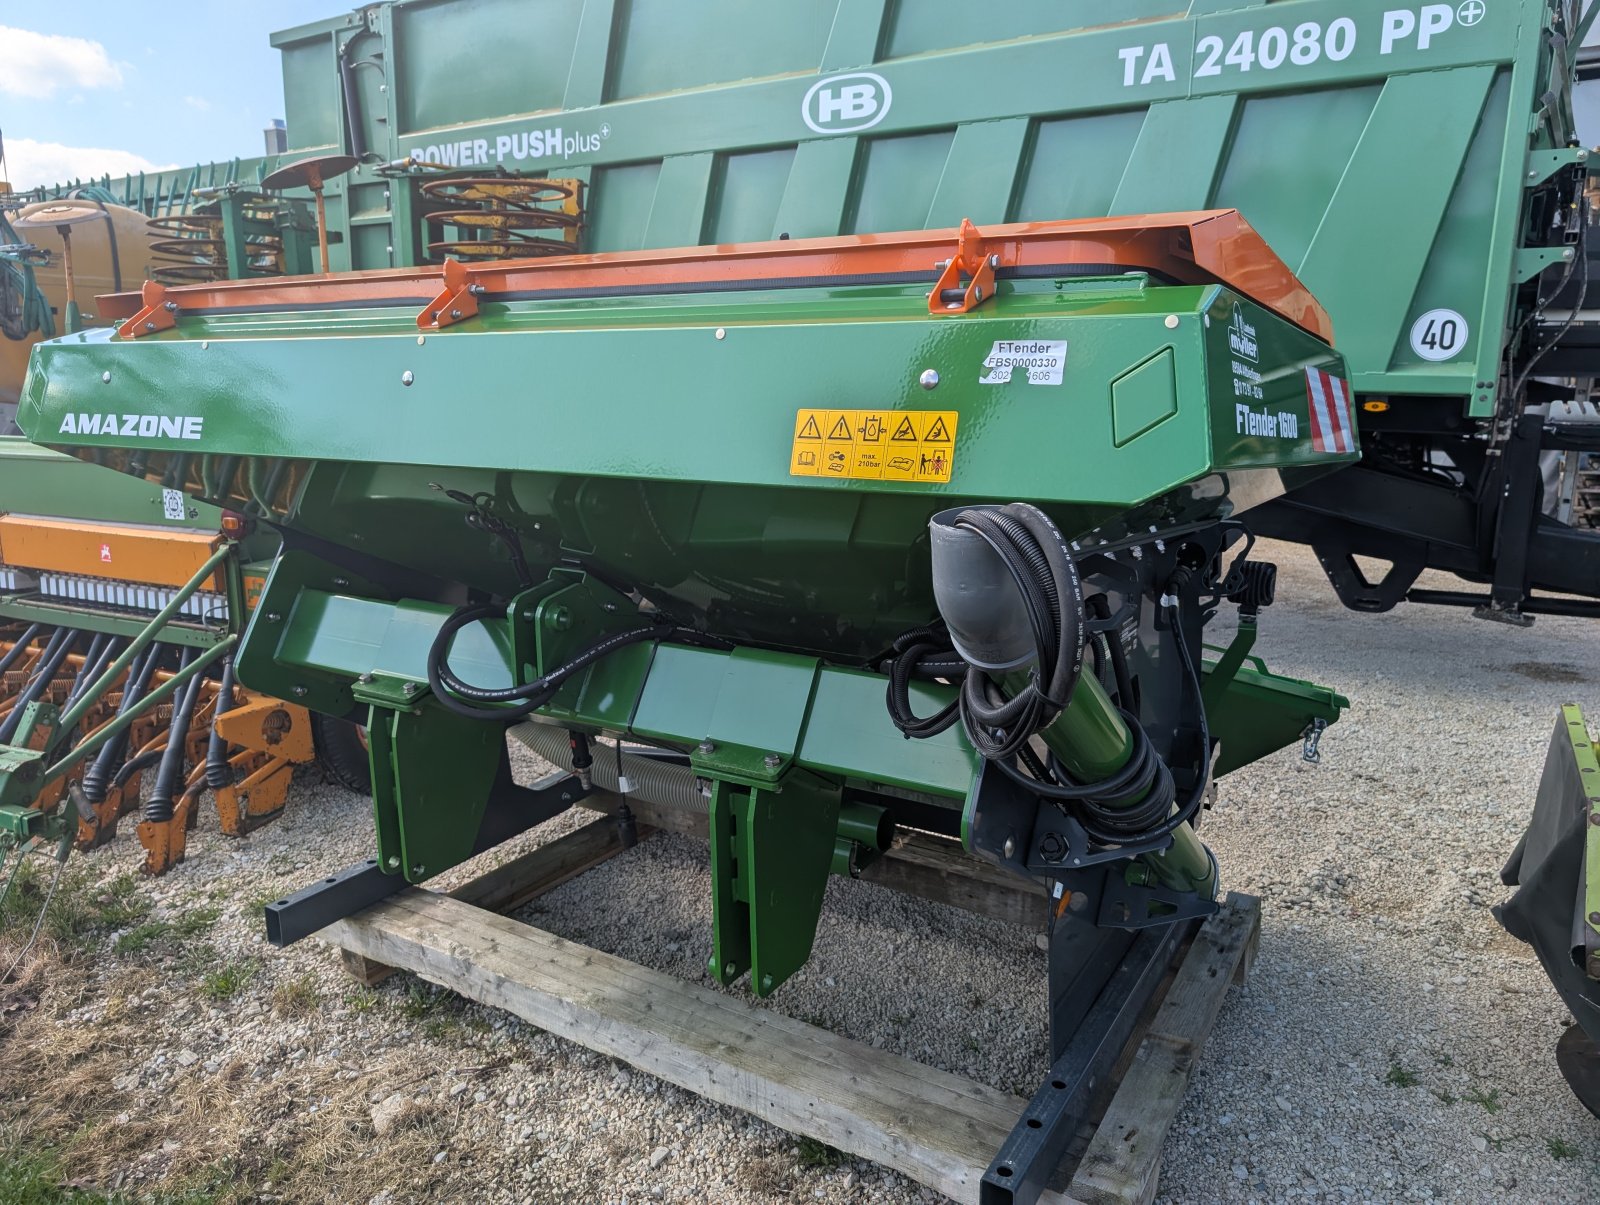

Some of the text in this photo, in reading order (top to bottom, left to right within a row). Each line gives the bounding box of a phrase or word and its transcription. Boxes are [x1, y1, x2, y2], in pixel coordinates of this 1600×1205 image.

[1118, 44, 1176, 86] TA
[1194, 17, 1357, 78] 24080
[819, 84, 877, 122] HB
[998, 342, 1051, 353] FTender
[1421, 320, 1456, 350] 40
[988, 358, 1057, 368] FBS0000330
[58, 413, 204, 440] AMAZONE
[1235, 403, 1298, 439] FTender 1600
